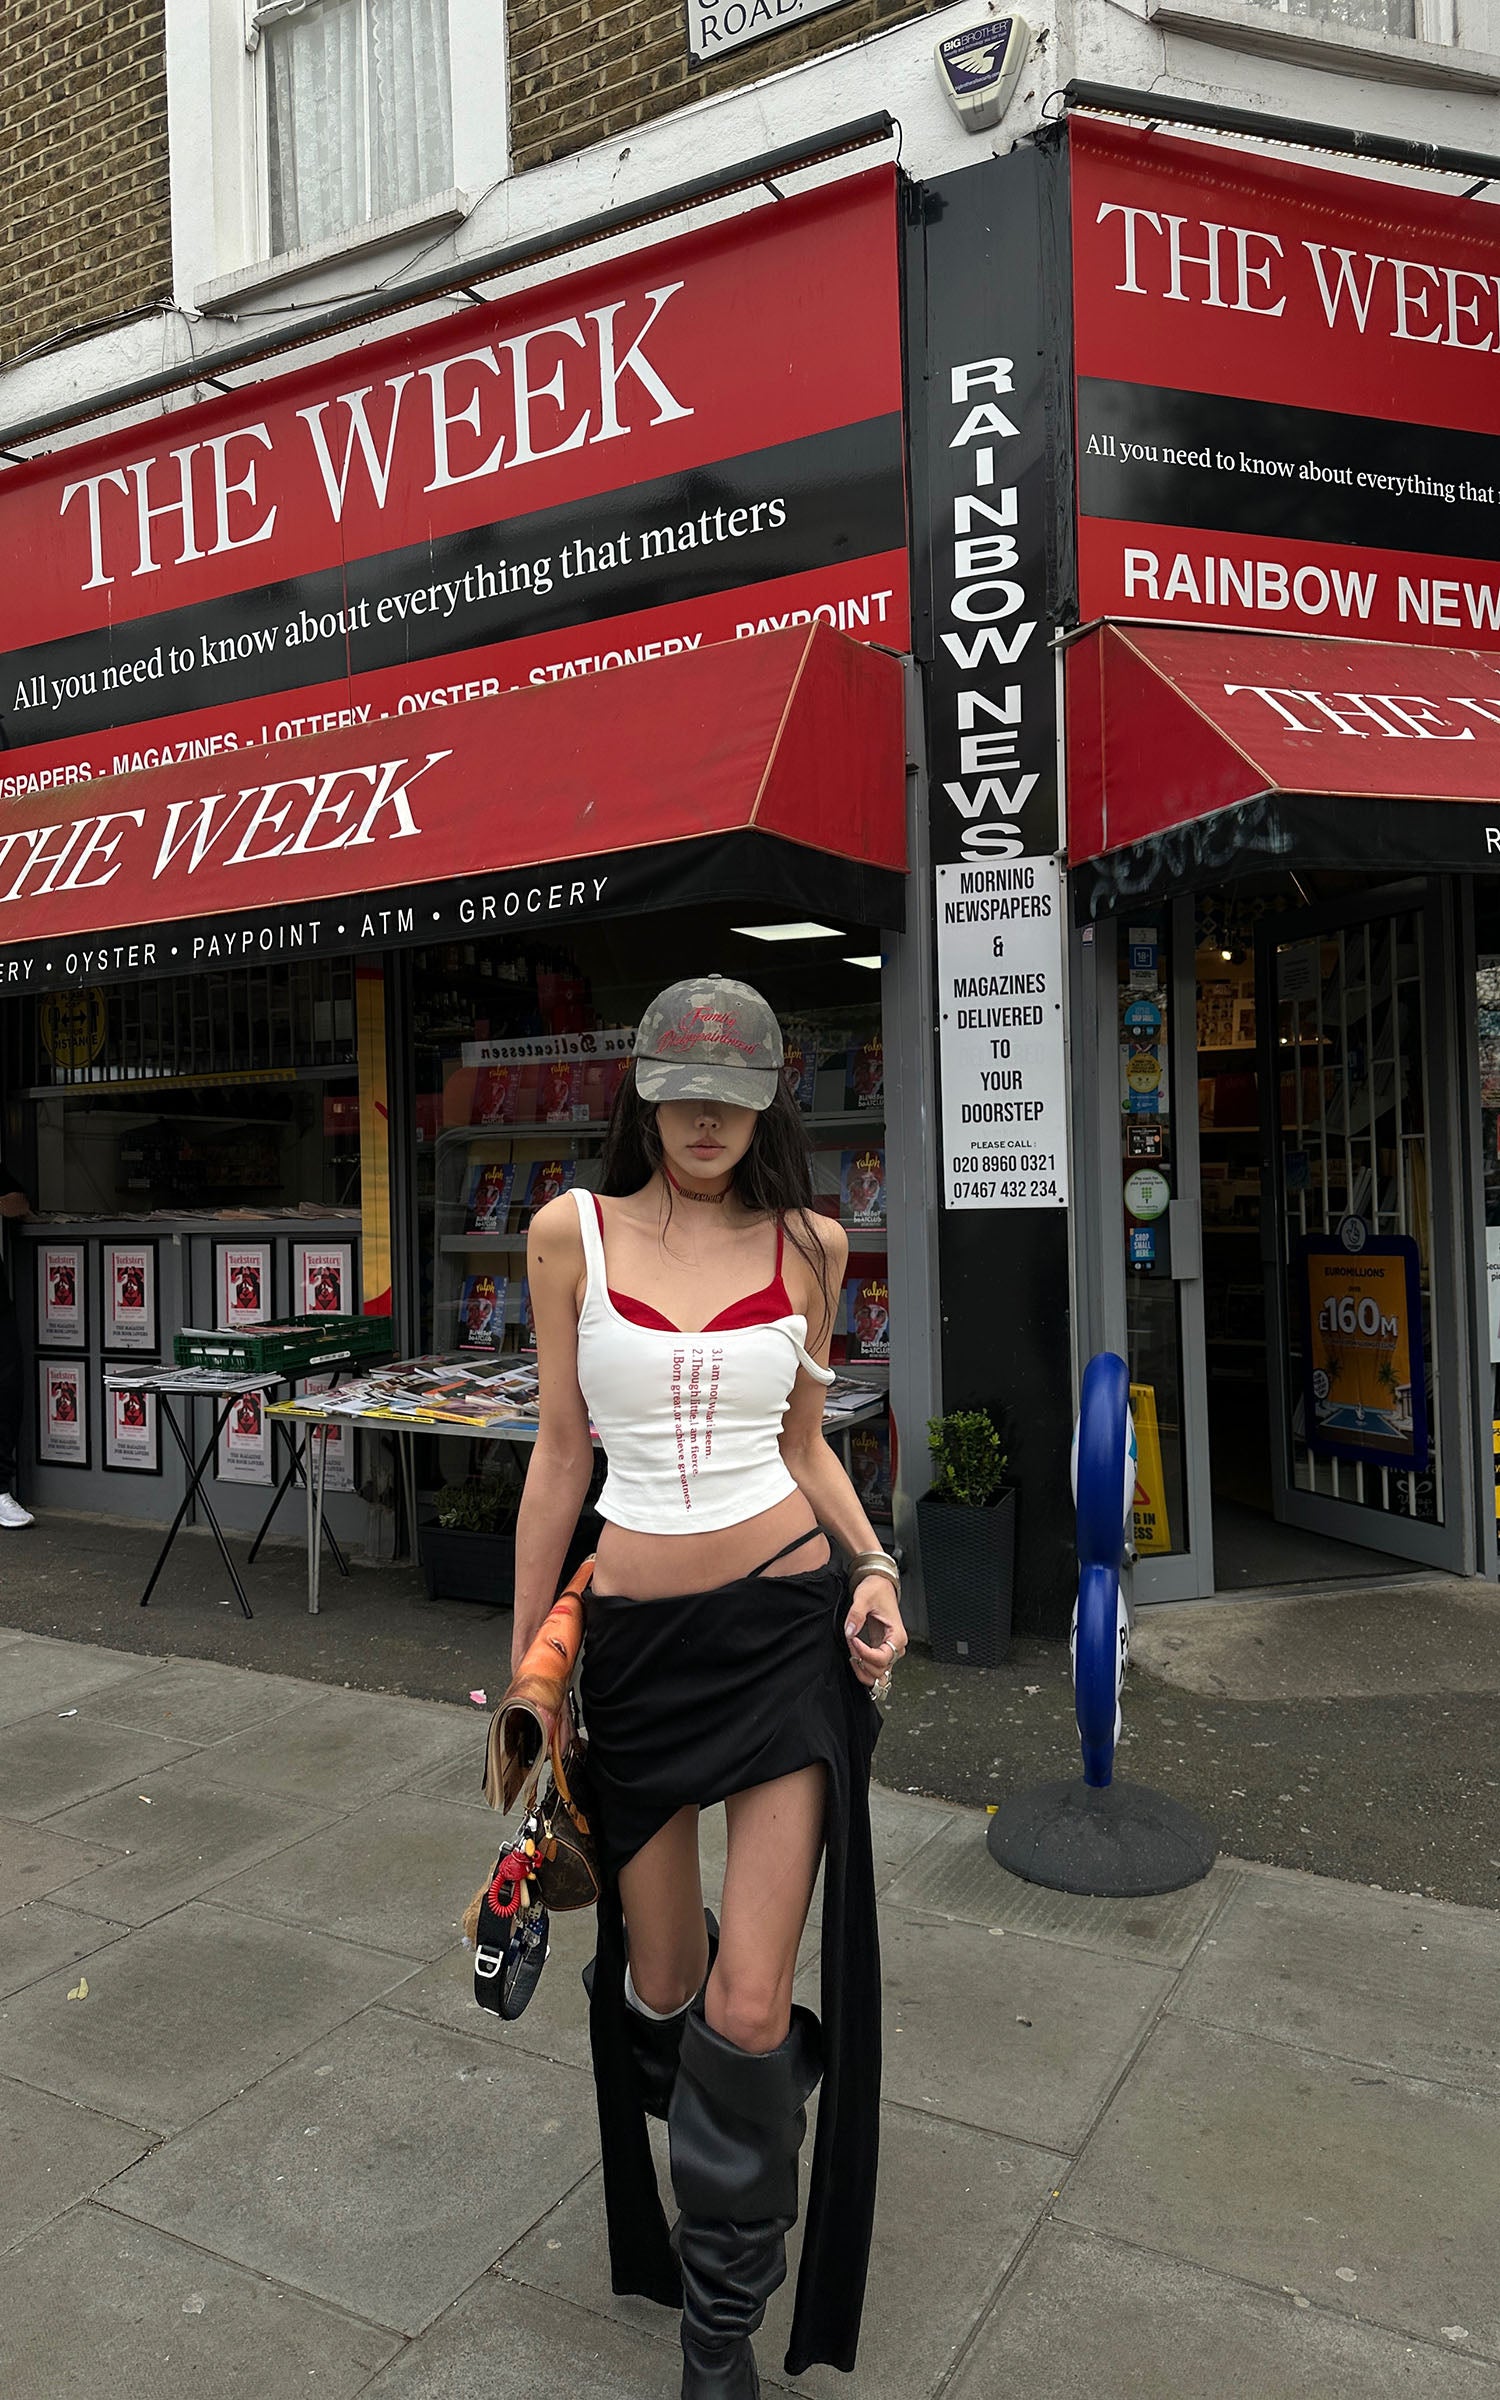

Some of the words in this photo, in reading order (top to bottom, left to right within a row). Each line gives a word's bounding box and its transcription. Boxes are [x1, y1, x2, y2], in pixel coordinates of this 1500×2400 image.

[1096, 202, 1287, 317] THE
[1302, 241, 1500, 354] WEE
[60, 422, 278, 591] THE
[296, 283, 695, 523] WEEK
[1085, 433, 1116, 457] All
[1119, 440, 1159, 464] you
[1162, 447, 1212, 469] need
[1215, 450, 1236, 472] to
[1239, 451, 1296, 478] know
[1298, 460, 1353, 486] about
[1356, 471, 1456, 503] everything
[1458, 481, 1495, 505] that
[940, 356, 1037, 670] RAINBOW
[1124, 547, 1378, 619] RAINBOW
[12, 675, 47, 711] All
[51, 670, 98, 711] you
[102, 647, 165, 692] need
[168, 645, 196, 673] to
[200, 625, 280, 669] know
[284, 604, 372, 648] about
[376, 556, 554, 623] everything
[558, 531, 634, 579] that
[639, 497, 787, 560] matters
[1223, 683, 1476, 741] THE
[113, 732, 239, 775] MAGAZINES
[261, 703, 372, 746] LOTTERY
[397, 677, 500, 716] OYSTER
[943, 684, 1040, 862] NEWS
[0, 808, 146, 902] THE
[152, 749, 454, 880] WEEK
[959, 867, 1034, 895] MORNING
[945, 895, 1052, 924] NEWSPAPERS
[65, 942, 158, 976] OYSTER
[192, 920, 323, 960] PAYPOINT
[360, 908, 416, 938] ATM
[459, 876, 610, 924] GROCERY
[992, 935, 1004, 958] &
[953, 973, 1046, 999] MAGAZINES
[957, 1006, 1044, 1030] DELIVERED
[990, 1039, 1011, 1060] TO
[980, 1070, 1023, 1091] YOUR
[961, 1101, 1044, 1124] DOORSTEP
[970, 1141, 1007, 1150] PLEASE
[543, 1161, 563, 1178] ralph
[856, 1151, 881, 1173] ralph
[953, 1156, 979, 1174] 020
[981, 1155, 1020, 1173] 8960
[1020, 1154, 1056, 1172] 0321
[485, 1165, 503, 1184] ralph
[953, 1181, 999, 1199] 07467
[1000, 1180, 1027, 1198] 432
[1030, 1180, 1057, 1198] 234
[1133, 1241, 1152, 1250] SMALL
[1134, 1233, 1150, 1242] SHOP
[1324, 1266, 1385, 1279] EUROMILLIONS
[476, 1277, 495, 1297] ralph
[862, 1280, 888, 1303] ralph
[711, 1364, 721, 1381] am
[709, 1384, 719, 1400] not
[675, 1424, 686, 1460] achieve
[690, 1428, 697, 1443] am
[705, 1429, 713, 1460] seem.
[691, 1446, 700, 1478] fierce.
[677, 1463, 692, 1513] greatness.
[1143, 1512, 1156, 1525] IN
